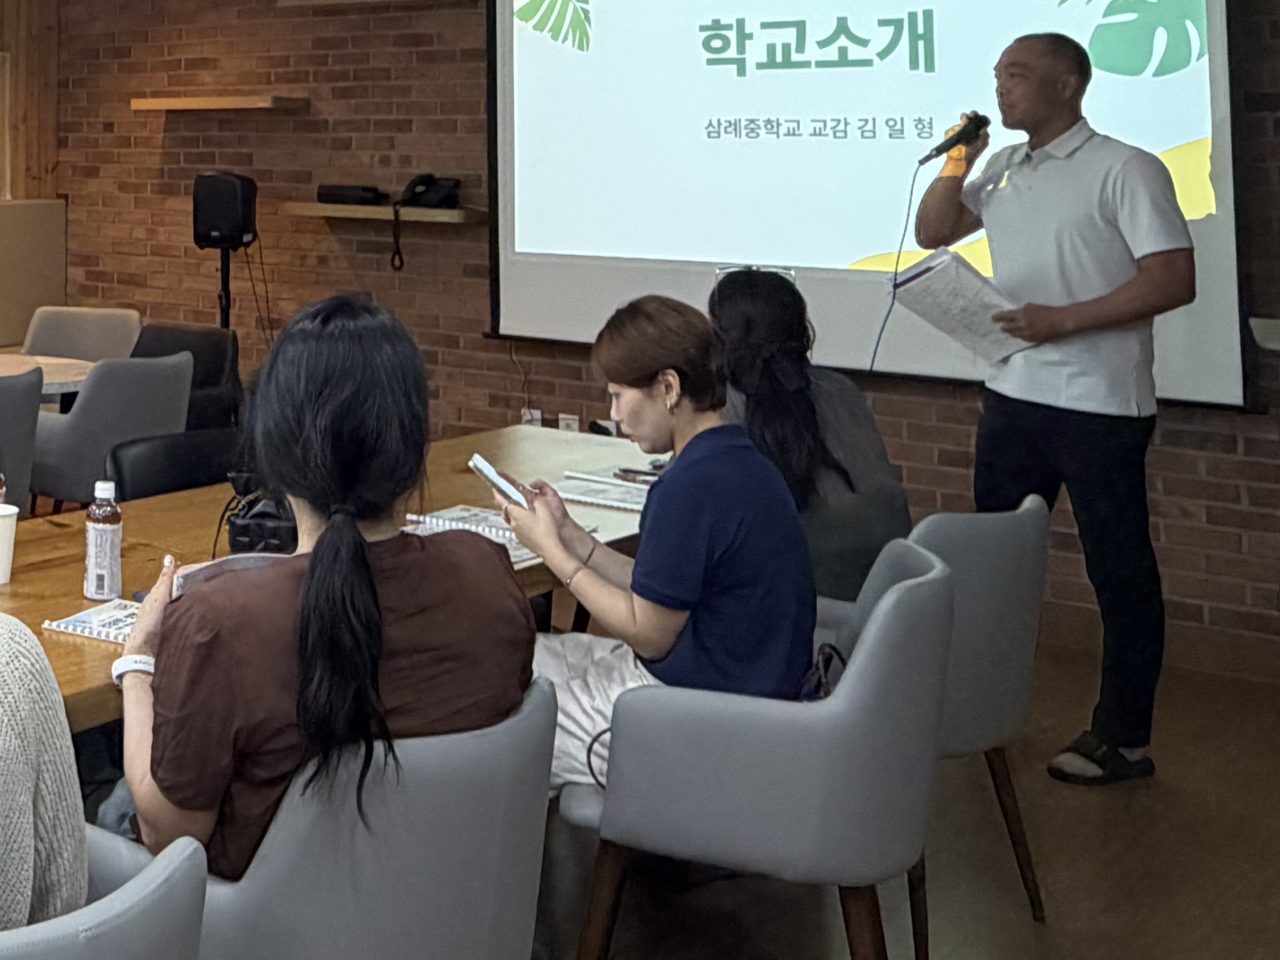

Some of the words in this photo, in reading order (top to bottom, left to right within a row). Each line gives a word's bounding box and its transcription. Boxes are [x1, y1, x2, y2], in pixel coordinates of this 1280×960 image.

[698, 8, 936, 78] 학교소개
[704, 117, 803, 140] 삼례중학교
[808, 117, 851, 140] 교감
[856, 117, 878, 140] 김
[884, 116, 906, 140] 일
[913, 115, 935, 140] 형
